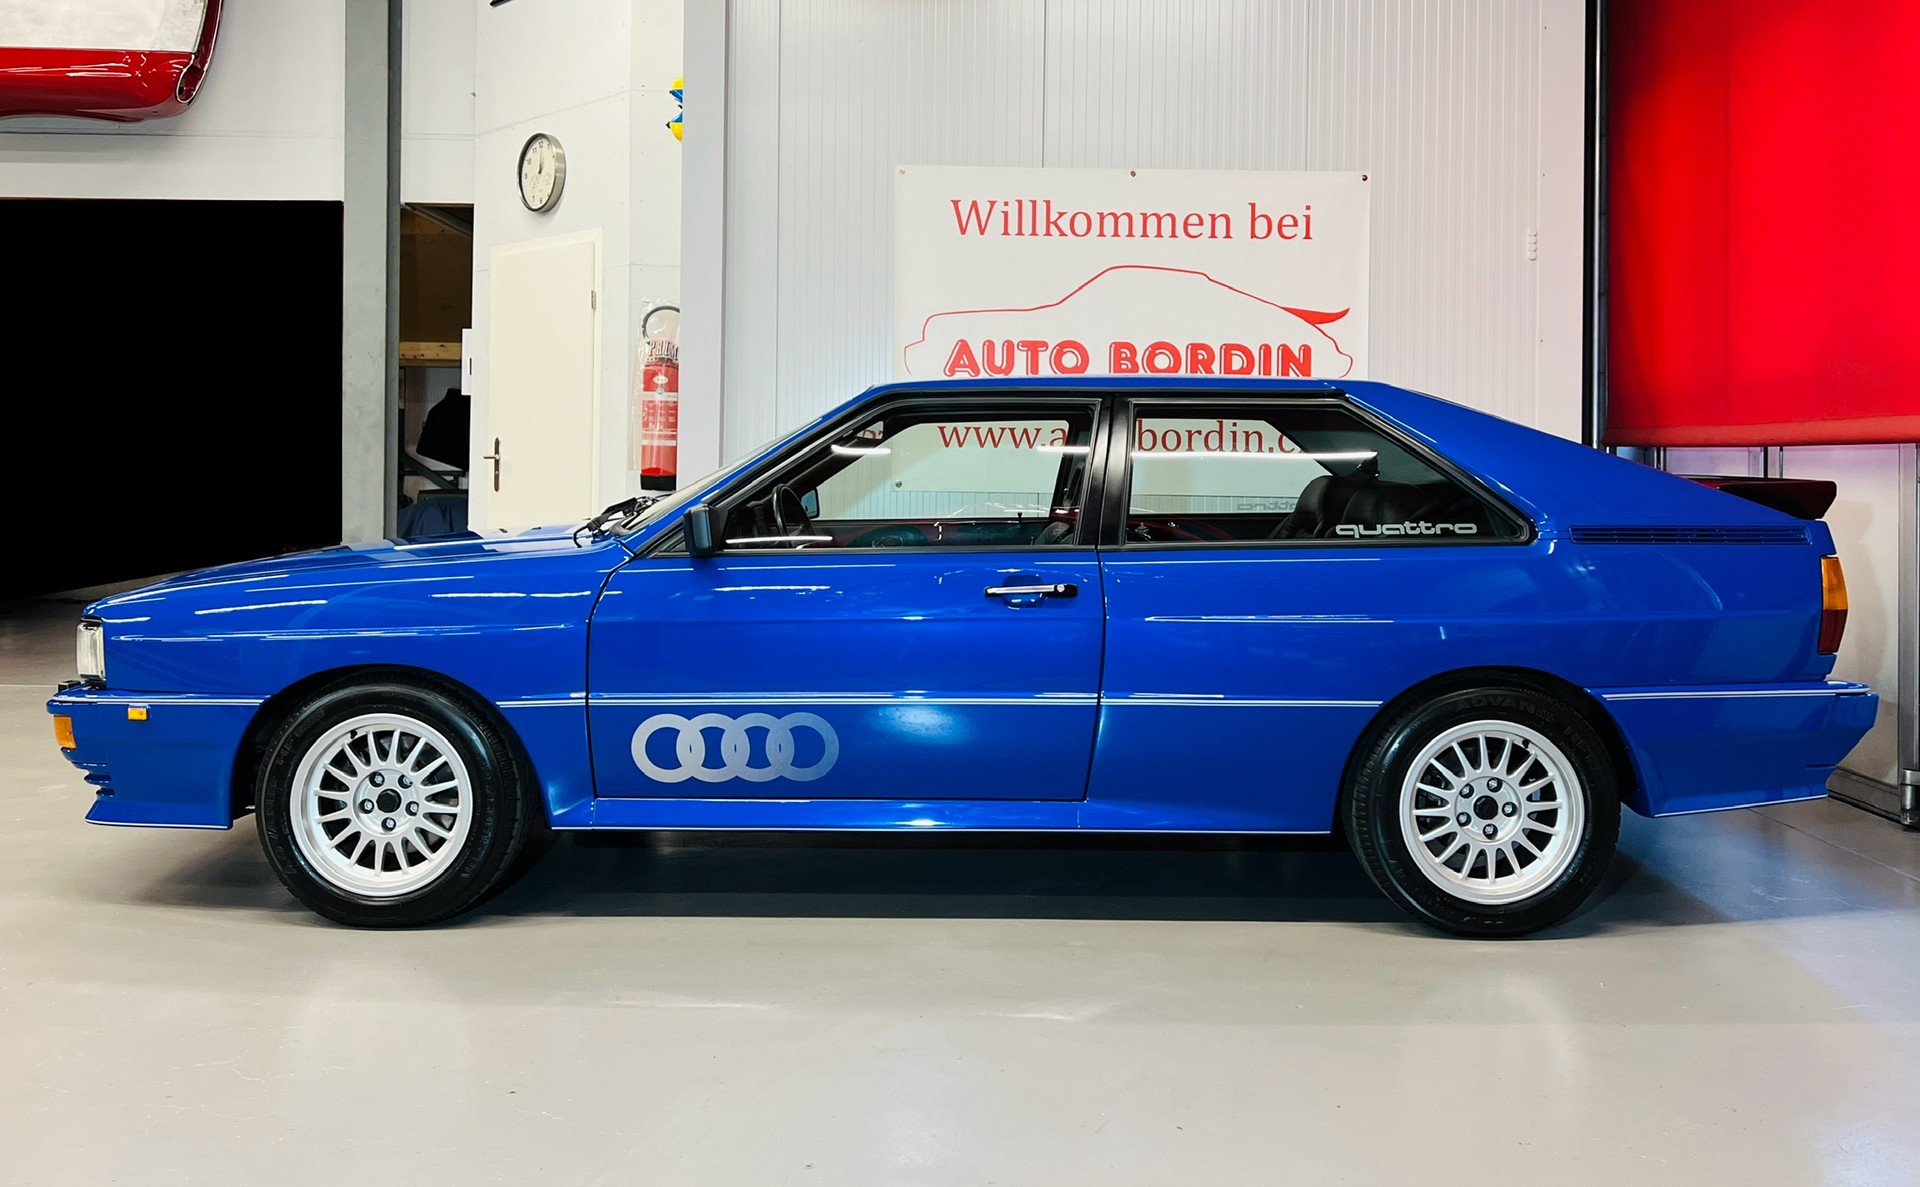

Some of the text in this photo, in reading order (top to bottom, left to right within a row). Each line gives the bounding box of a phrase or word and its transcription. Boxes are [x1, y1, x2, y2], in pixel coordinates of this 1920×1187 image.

[951, 198, 1313, 241] Willkommen bei
[944, 338, 1312, 377] AUTO BORDIN
[1335, 520, 1478, 539] quattro
